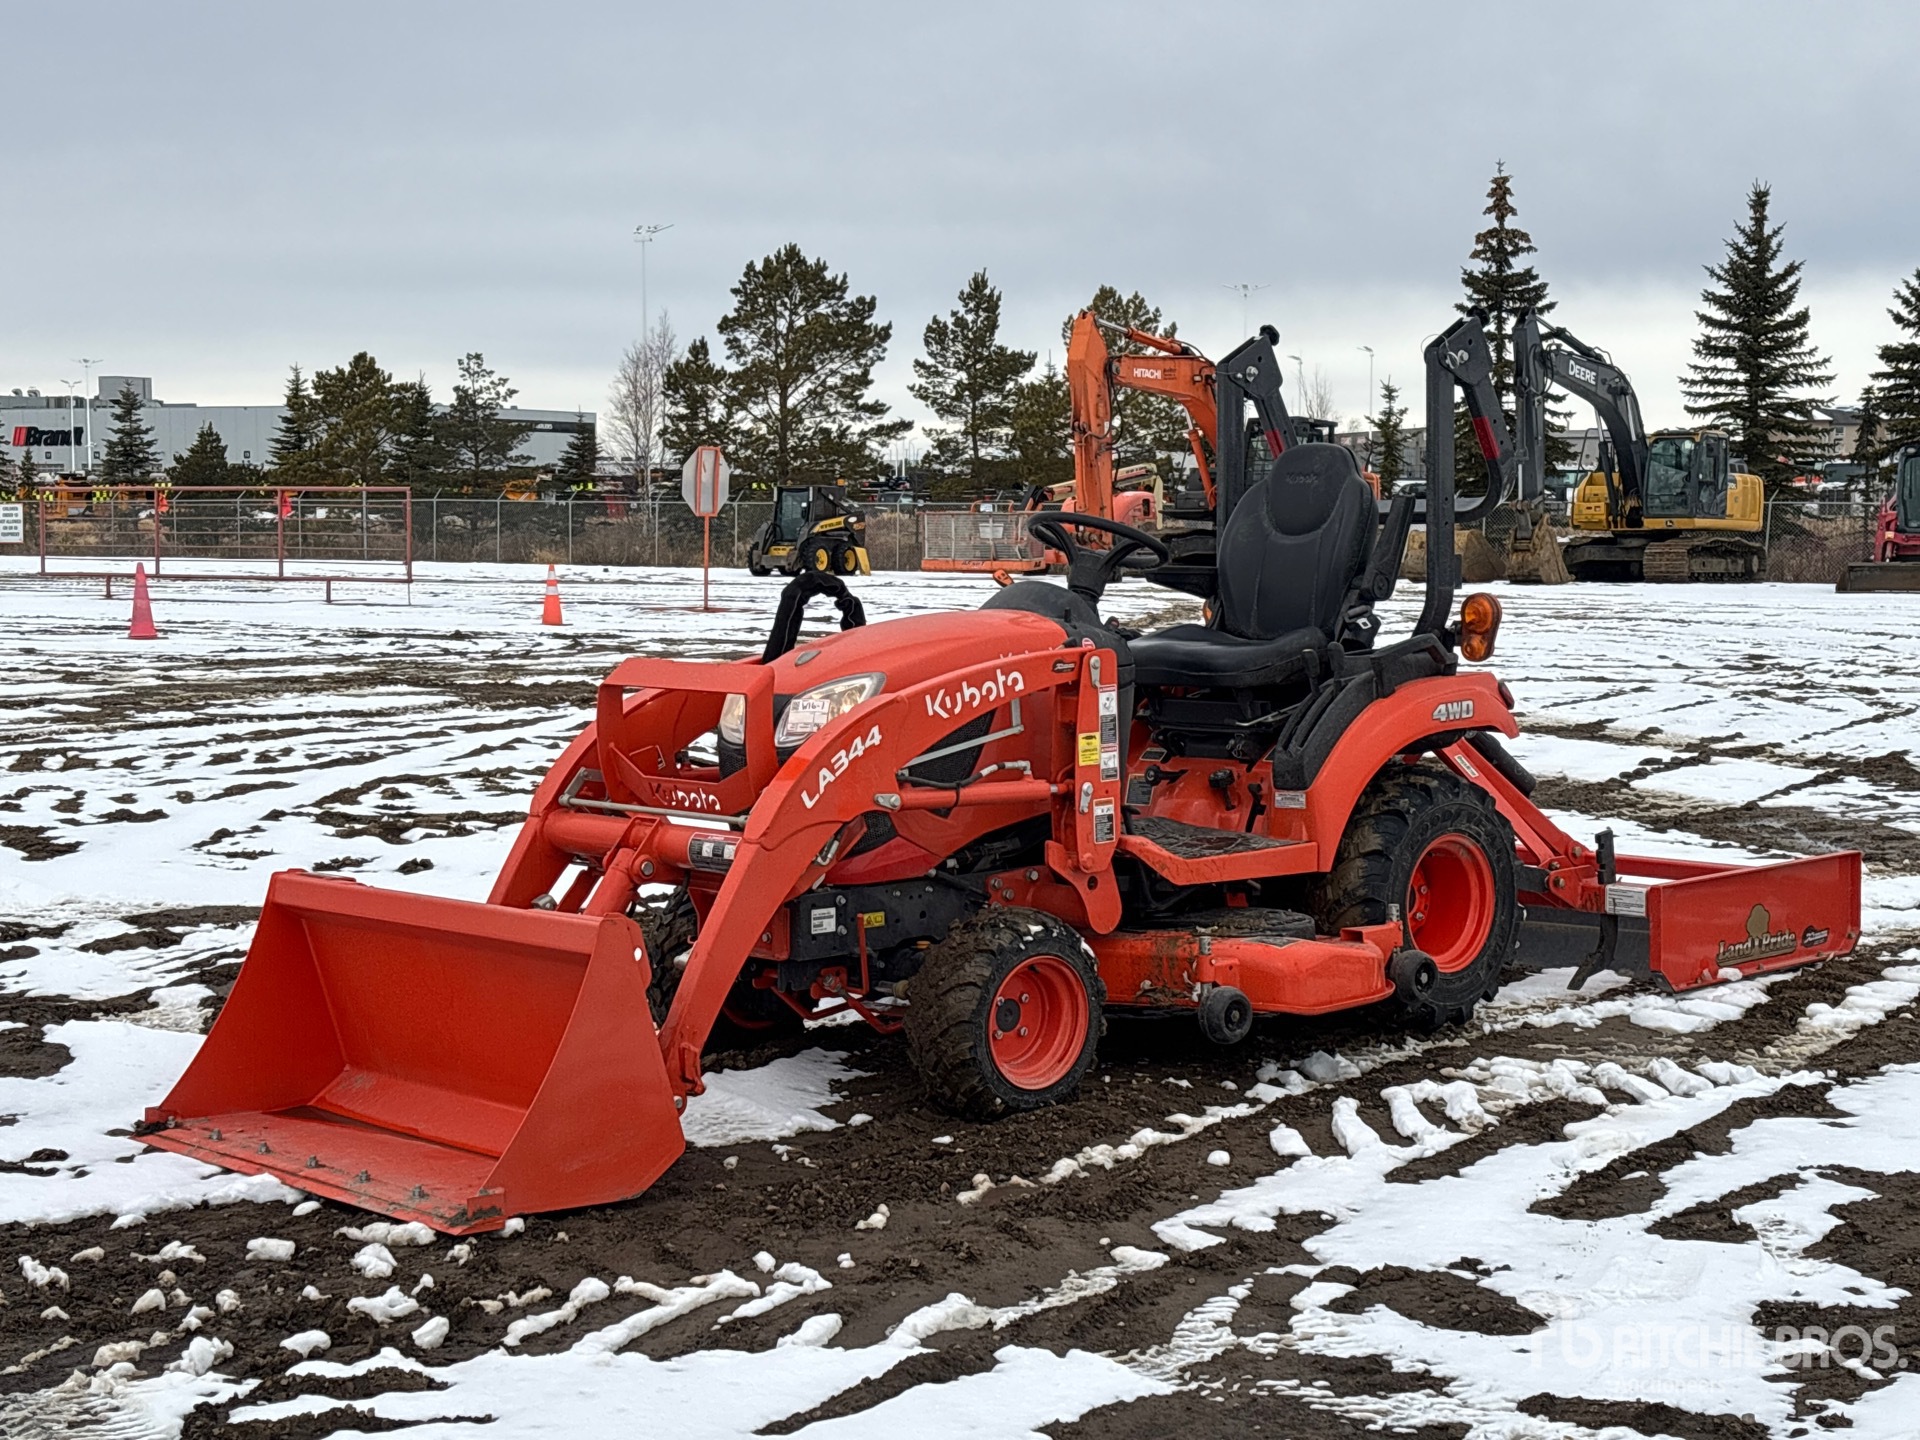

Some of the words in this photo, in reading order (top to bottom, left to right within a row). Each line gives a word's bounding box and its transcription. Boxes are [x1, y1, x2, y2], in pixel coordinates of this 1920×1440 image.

[1133, 367, 1162, 380] HITACHI
[1568, 359, 1597, 386] DEERE
[925, 668, 1025, 719] Kubota
[1432, 699, 1474, 722] 4WD
[800, 724, 882, 809] LA344
[648, 782, 721, 811] Kubota
[1719, 937, 1753, 959] Land
[1761, 929, 1797, 952] Pride
